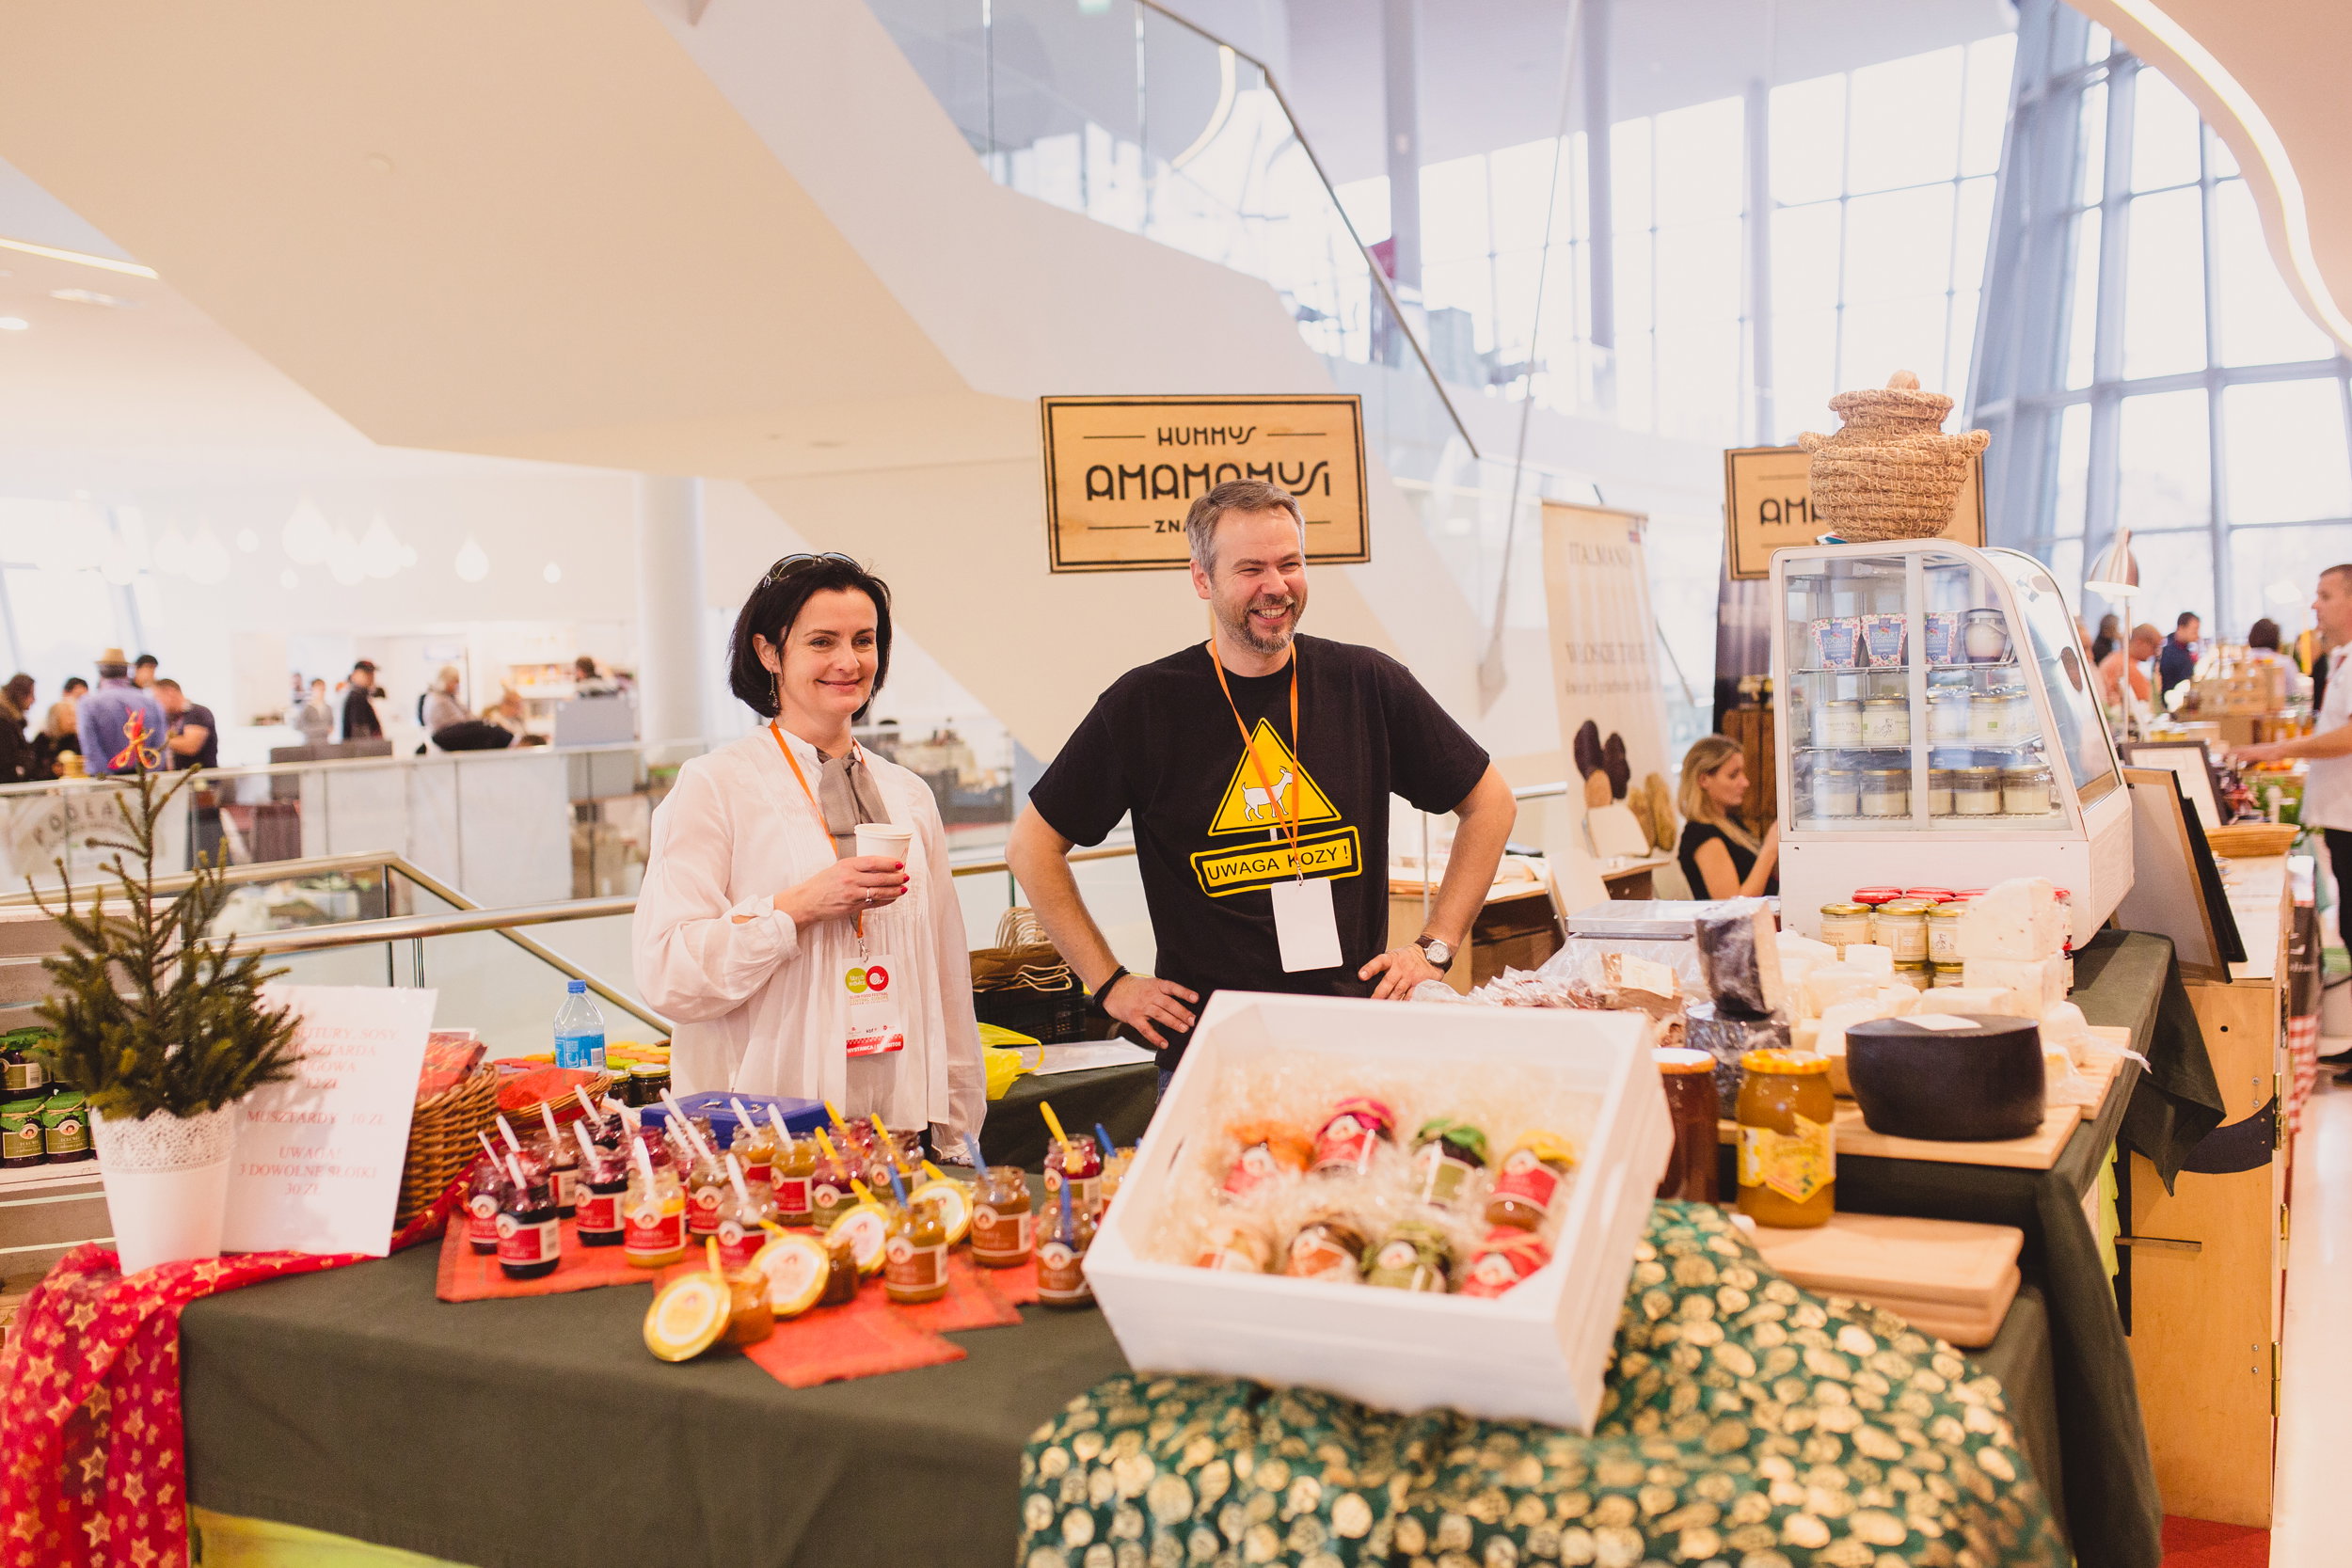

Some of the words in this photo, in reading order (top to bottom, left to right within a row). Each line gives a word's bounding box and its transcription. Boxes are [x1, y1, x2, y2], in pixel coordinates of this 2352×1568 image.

[1157, 425, 1257, 447] HUMMUS
[1153, 519, 1188, 533] ZN
[1207, 858, 1279, 880] UWAGA
[1287, 847, 1338, 868] KOZY
[246, 1110, 339, 1124] MUSZTARDY
[248, 1164, 325, 1177] DOWOLNE
